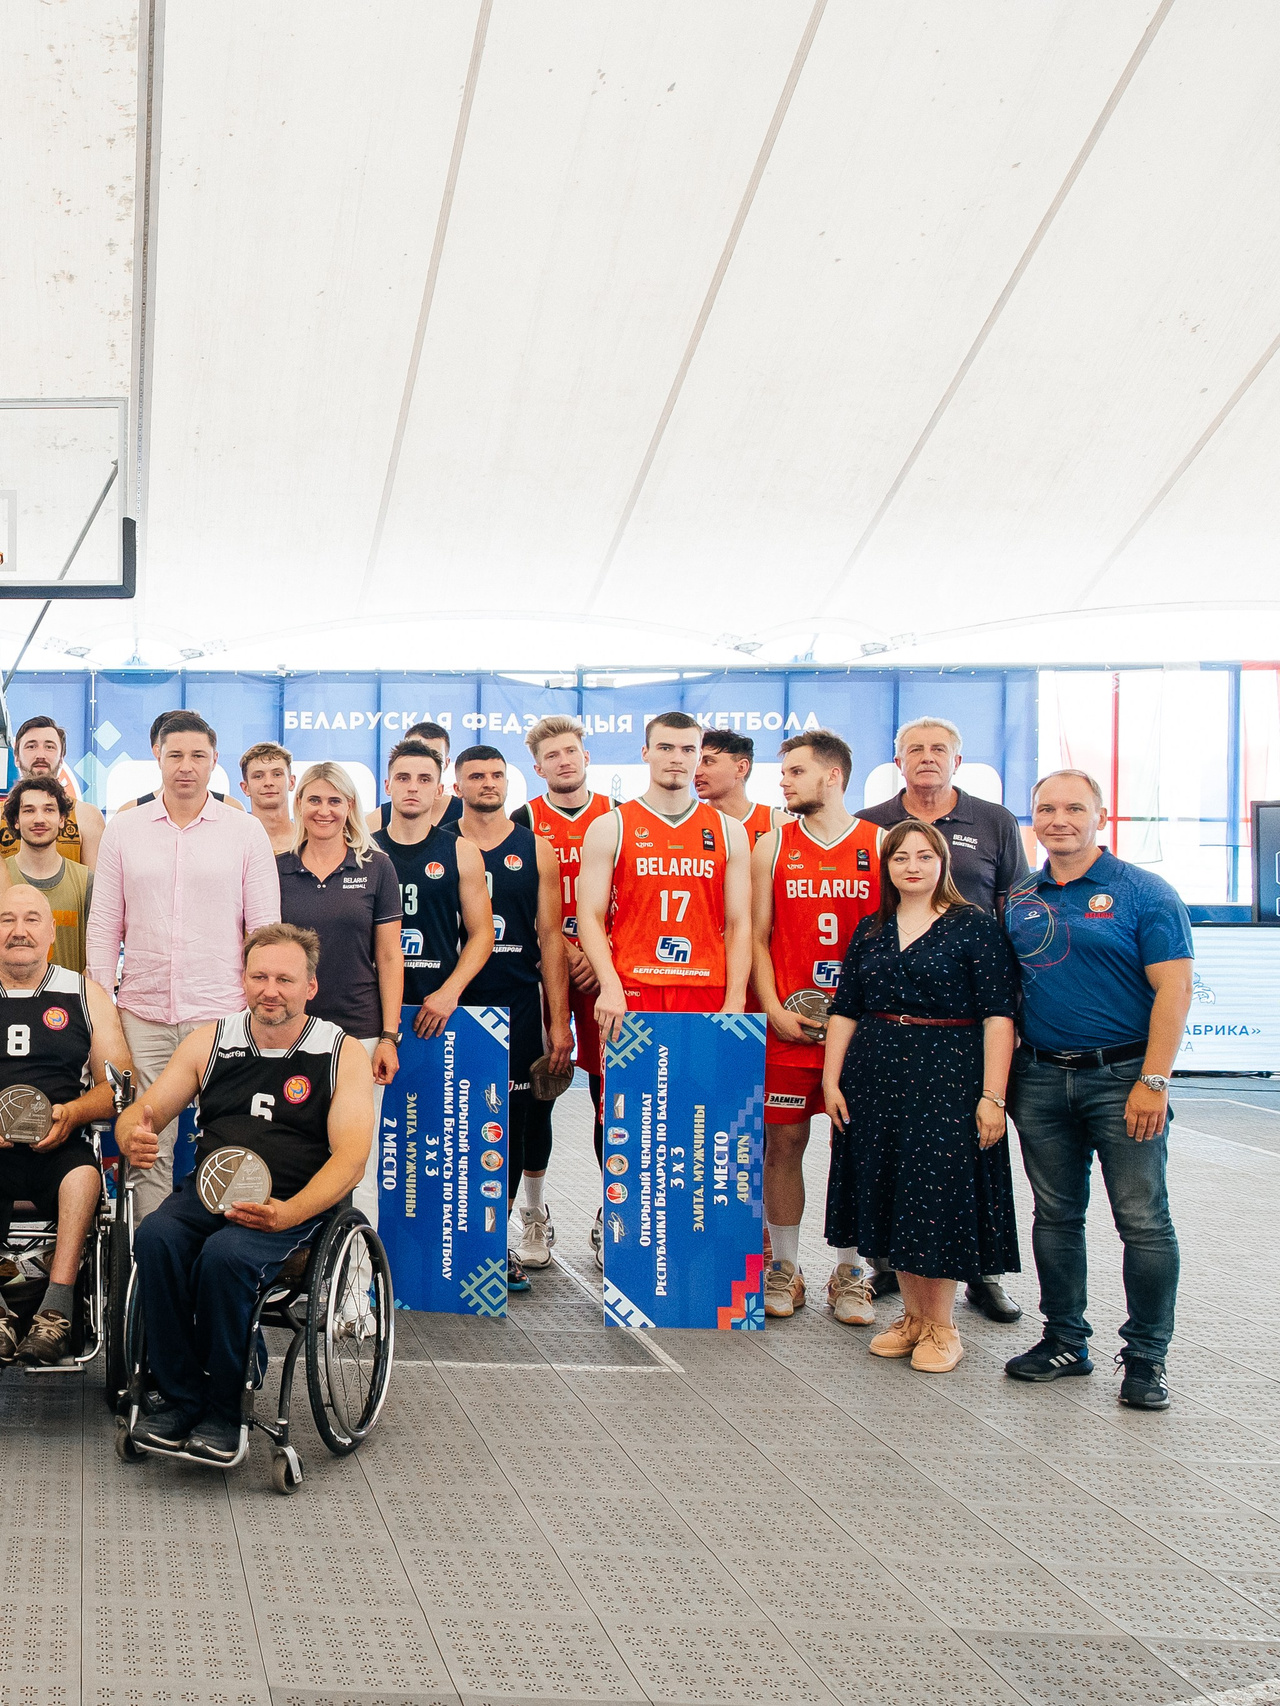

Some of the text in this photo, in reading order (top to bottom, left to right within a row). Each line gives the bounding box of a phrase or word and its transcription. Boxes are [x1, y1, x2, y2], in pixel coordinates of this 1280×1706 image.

[953, 834, 978, 844] BELARUS
[342, 876, 368, 884] BELARUS
[635, 856, 715, 879] BELARUS
[659, 889, 692, 923] 17
[785, 879, 871, 901] BELARUS
[817, 912, 839, 946] 9
[632, 966, 711, 978] БЕЛГОСПИЩЕПРОМ
[6, 1023, 31, 1057] 8
[218, 1050, 246, 1058] macron
[656, 1044, 669, 1120] БАСКЕТБОЛУ
[770, 1094, 805, 1105] ЭЛЕМЕНТ
[425, 1134, 440, 1146] 3
[641, 1092, 652, 1169] ЧЕМПИОНАТ
[656, 1122, 667, 1141] ПО
[382, 1117, 398, 1191] 2 МЕСТО
[405, 1091, 418, 1218] ЭЛИТА. МУЖЧИНЫ
[443, 1117, 455, 1179] БЕЛАРУСЬ
[670, 1146, 685, 1158] 3
[425, 1165, 439, 1177] 3
[655, 1144, 667, 1207] БЕЛАРУСЬ
[670, 1177, 685, 1190] 3
[693, 1104, 706, 1233] ЭЛИТА. МУЖЧИНЫ
[713, 1130, 729, 1207] 3 МЕСТО
[736, 1135, 750, 1203] 400 BYN
[442, 1182, 453, 1201] ПО
[457, 1155, 469, 1232] ЧЕМПИОНАТ
[442, 1203, 453, 1280] БАСКЕТБОЛУ
